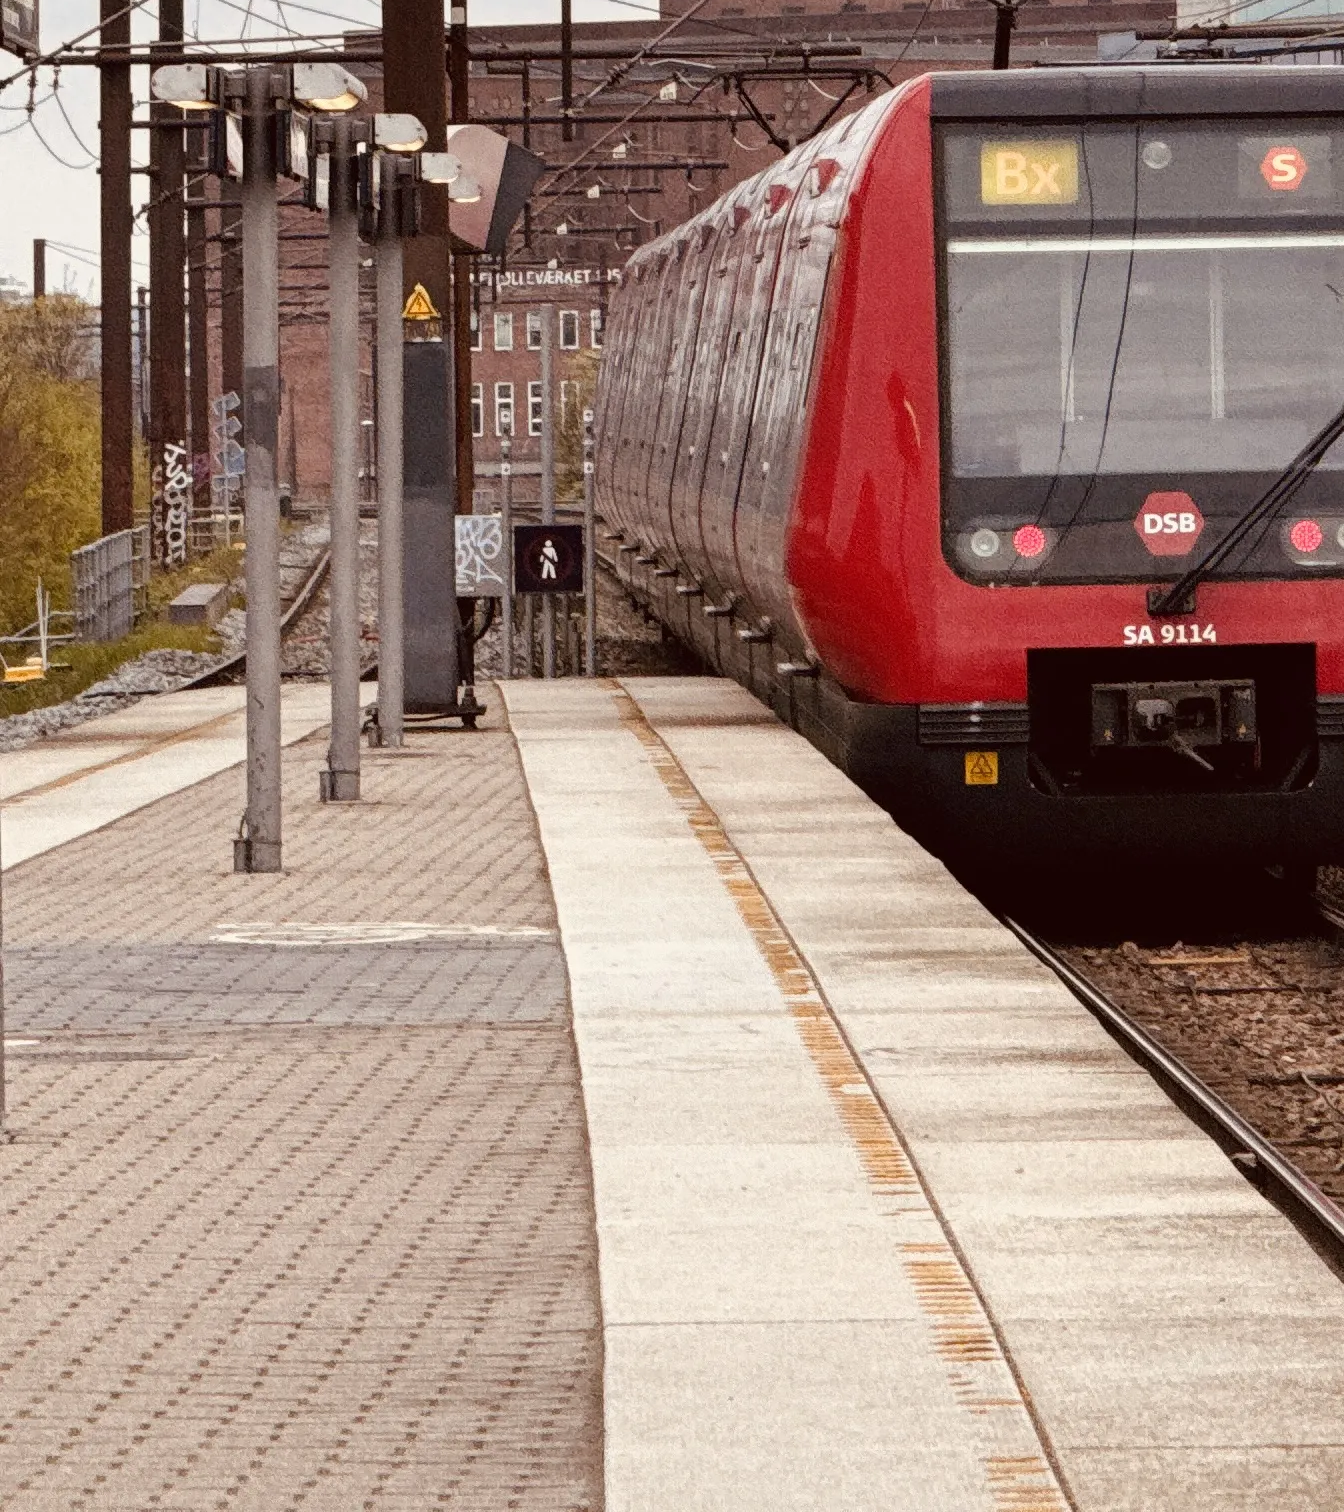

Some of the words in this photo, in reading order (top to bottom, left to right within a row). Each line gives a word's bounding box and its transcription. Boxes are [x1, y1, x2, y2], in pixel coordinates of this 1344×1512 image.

[995, 152, 1062, 196] Bx
[1272, 154, 1298, 183] S
[1143, 512, 1197, 535] DSB
[1122, 624, 1155, 646] SA
[1160, 623, 1218, 644] 9114
